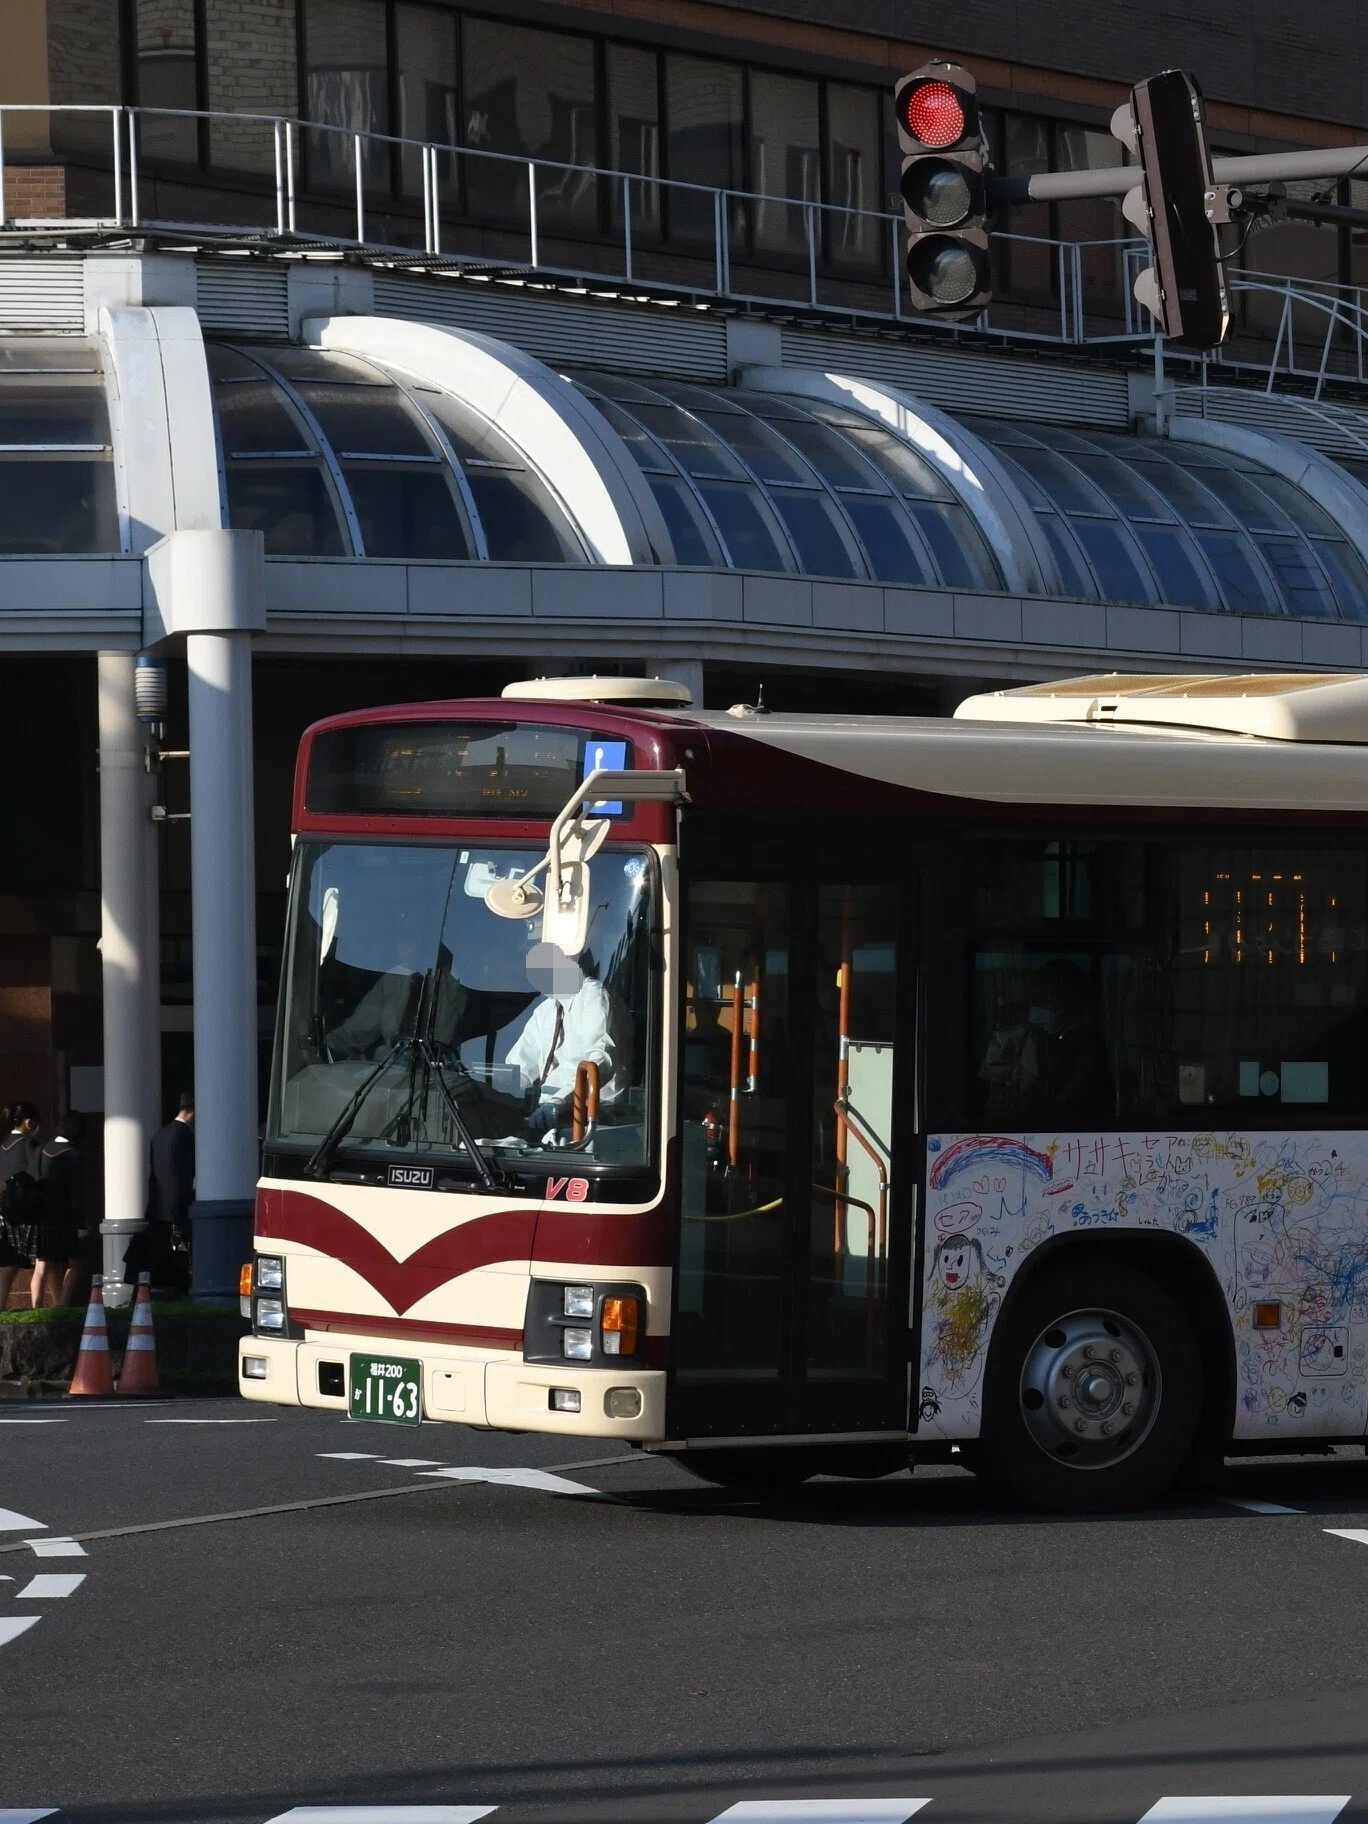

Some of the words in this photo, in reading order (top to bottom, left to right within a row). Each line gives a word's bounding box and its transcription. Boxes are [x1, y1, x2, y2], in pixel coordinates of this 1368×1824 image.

[391, 1169, 430, 1184] ISUZU
[545, 1177, 589, 1201] V8
[370, 1362, 403, 1378] 福井200
[354, 1388, 362, 1400] か
[366, 1377, 418, 1418] 11-63
